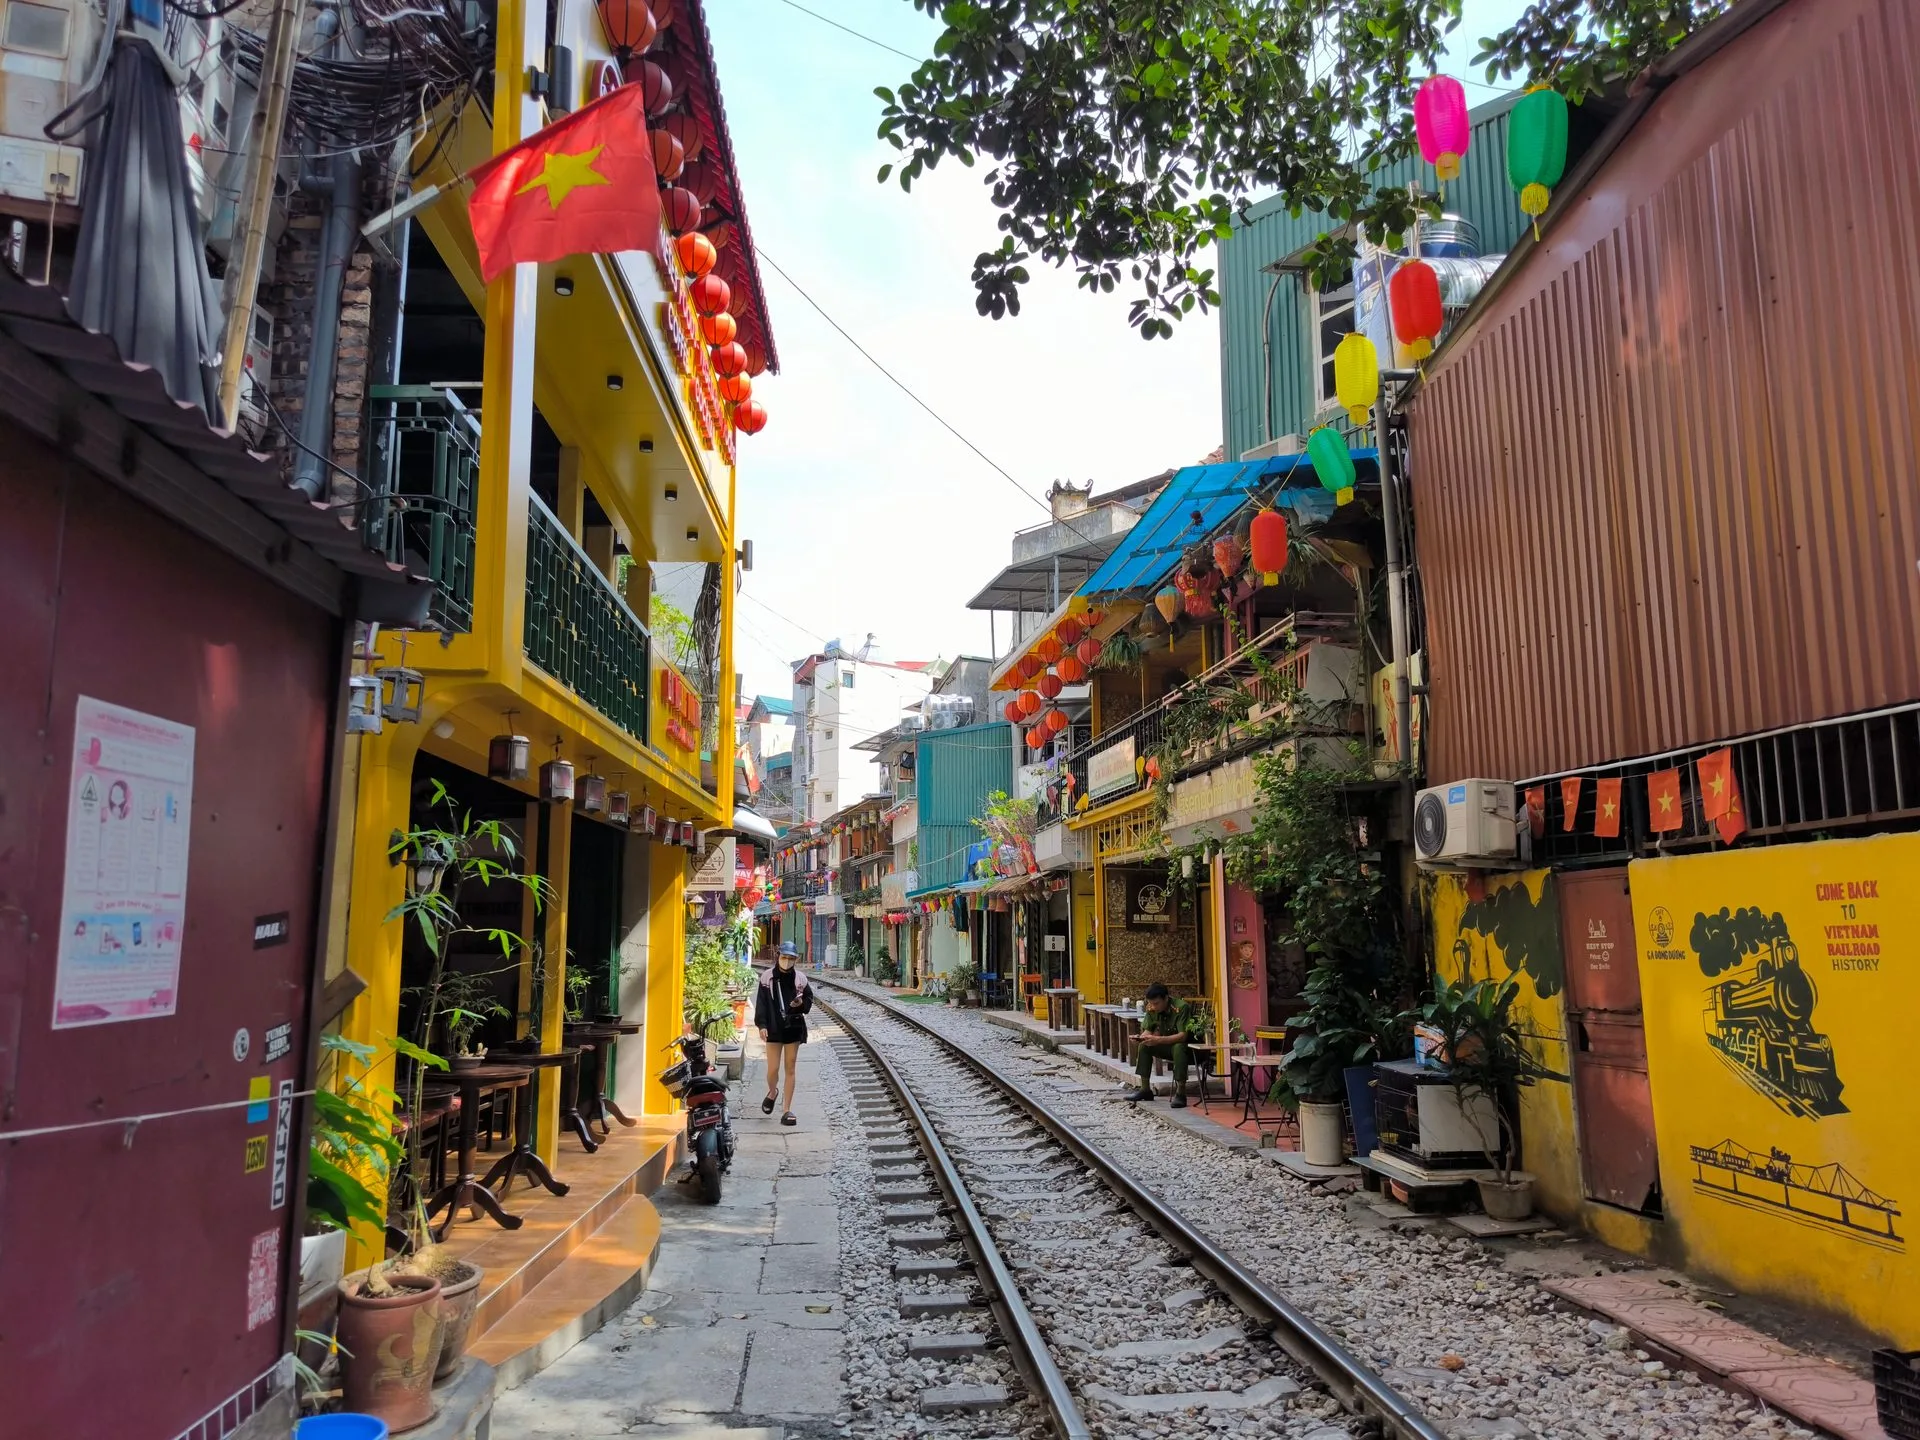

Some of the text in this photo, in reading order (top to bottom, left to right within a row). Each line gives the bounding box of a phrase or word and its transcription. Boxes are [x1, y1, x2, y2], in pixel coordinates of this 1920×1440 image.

[1816, 880, 1879, 901] COME BACK
[1841, 903, 1856, 920] TO
[1823, 924, 1879, 939] VIETNAM
[1827, 942, 1880, 956] RAILROAD
[1832, 958, 1880, 971] HISTORY
